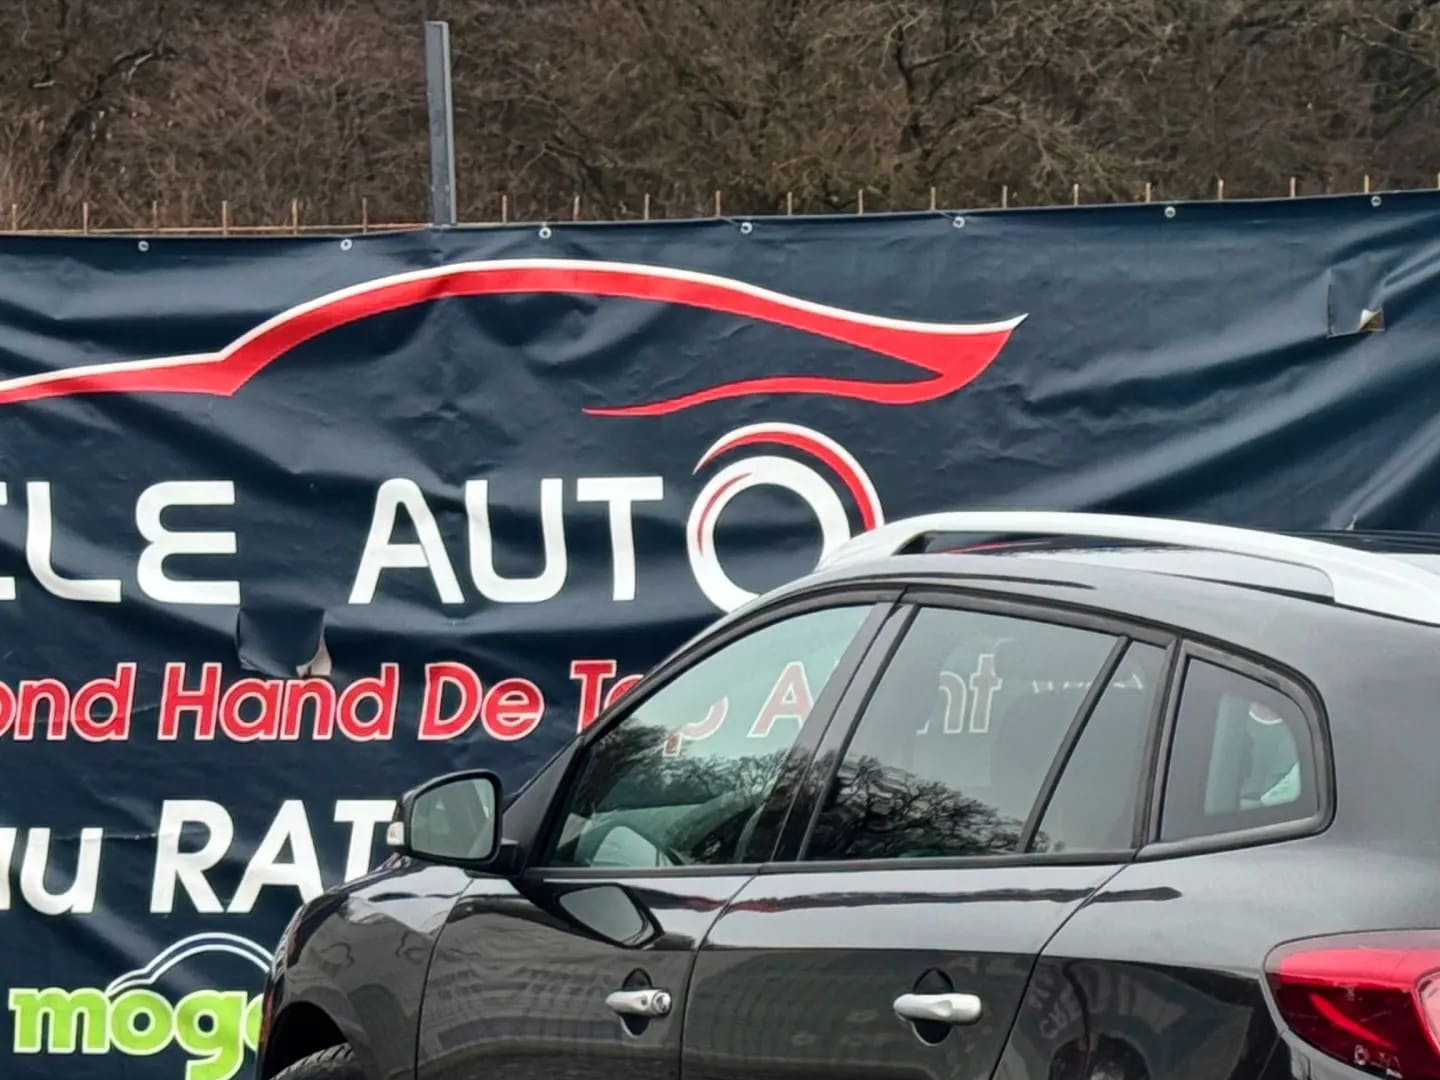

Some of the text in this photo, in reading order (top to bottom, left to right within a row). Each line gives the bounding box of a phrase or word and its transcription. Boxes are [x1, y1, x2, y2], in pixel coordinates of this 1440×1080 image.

[0, 455, 850, 613] LE AUTO
[157, 661, 401, 741] Hand
[418, 662, 545, 740] De
